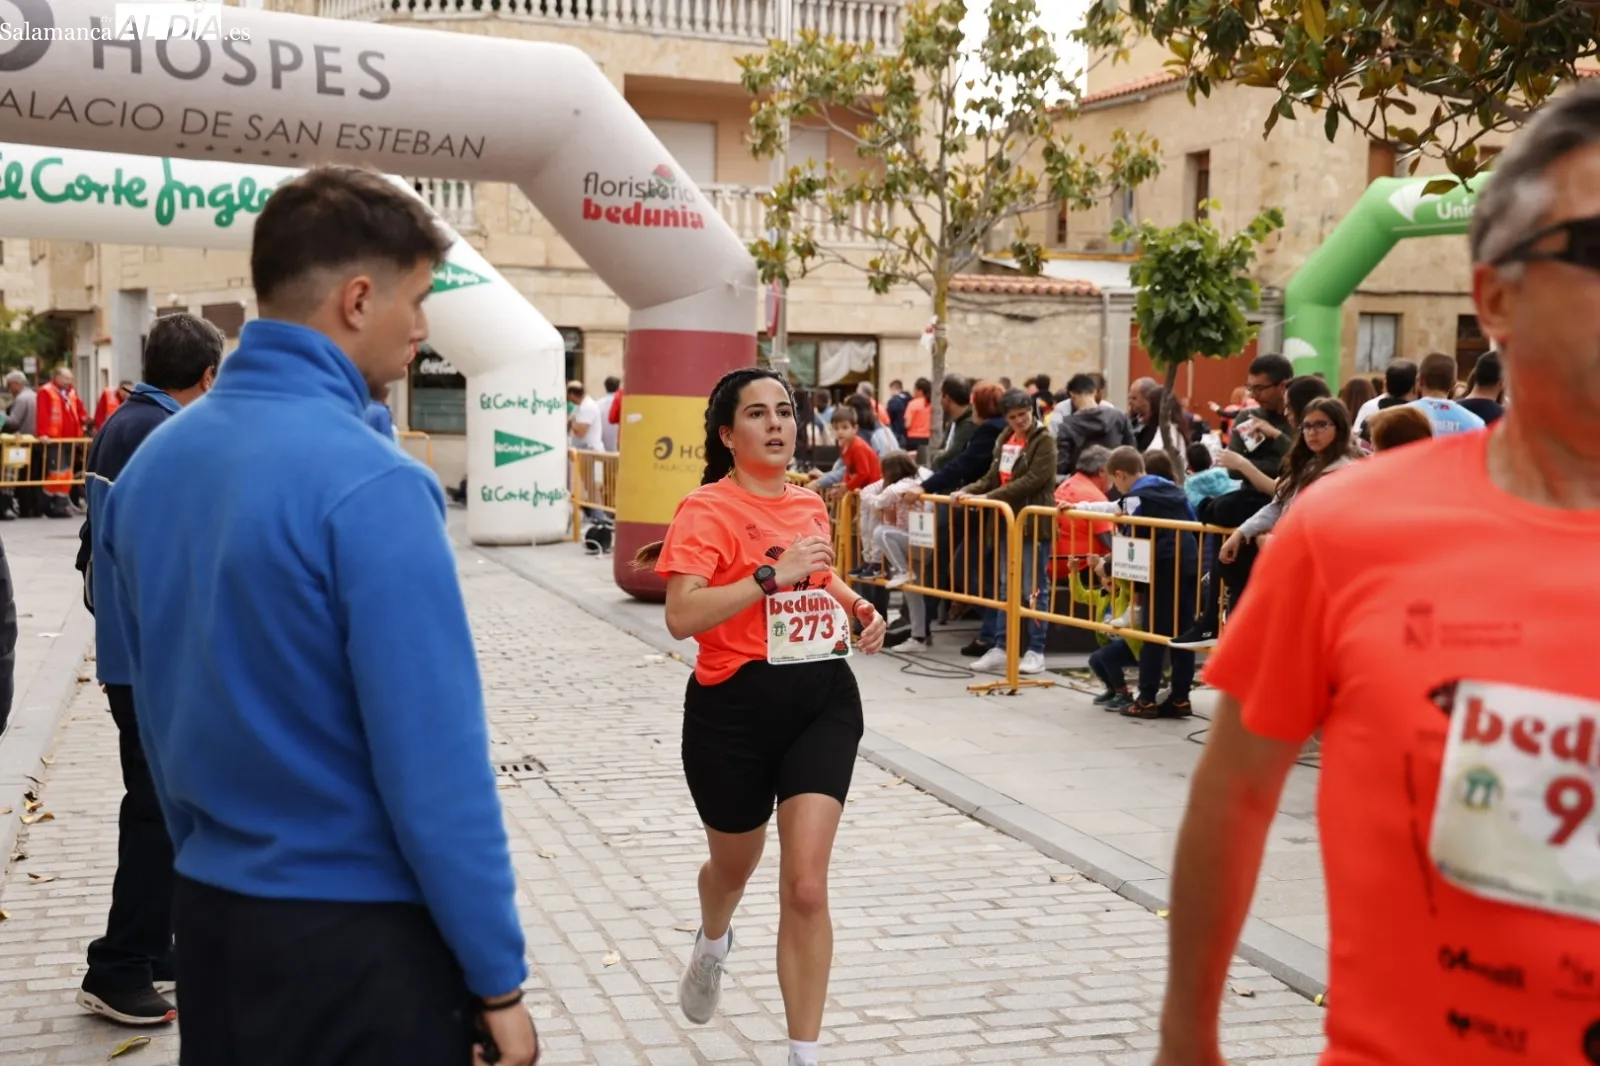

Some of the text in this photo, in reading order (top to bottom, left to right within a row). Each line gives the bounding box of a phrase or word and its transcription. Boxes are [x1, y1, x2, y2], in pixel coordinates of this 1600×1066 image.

[90, 16, 391, 101] HOSPES
[0, 88, 486, 160] ALACIO DE SAN ESTEBAN
[31, 157, 149, 209] Corte
[582, 197, 704, 230] bedunia
[788, 613, 834, 643] 273
[1544, 774, 1600, 846] 9
